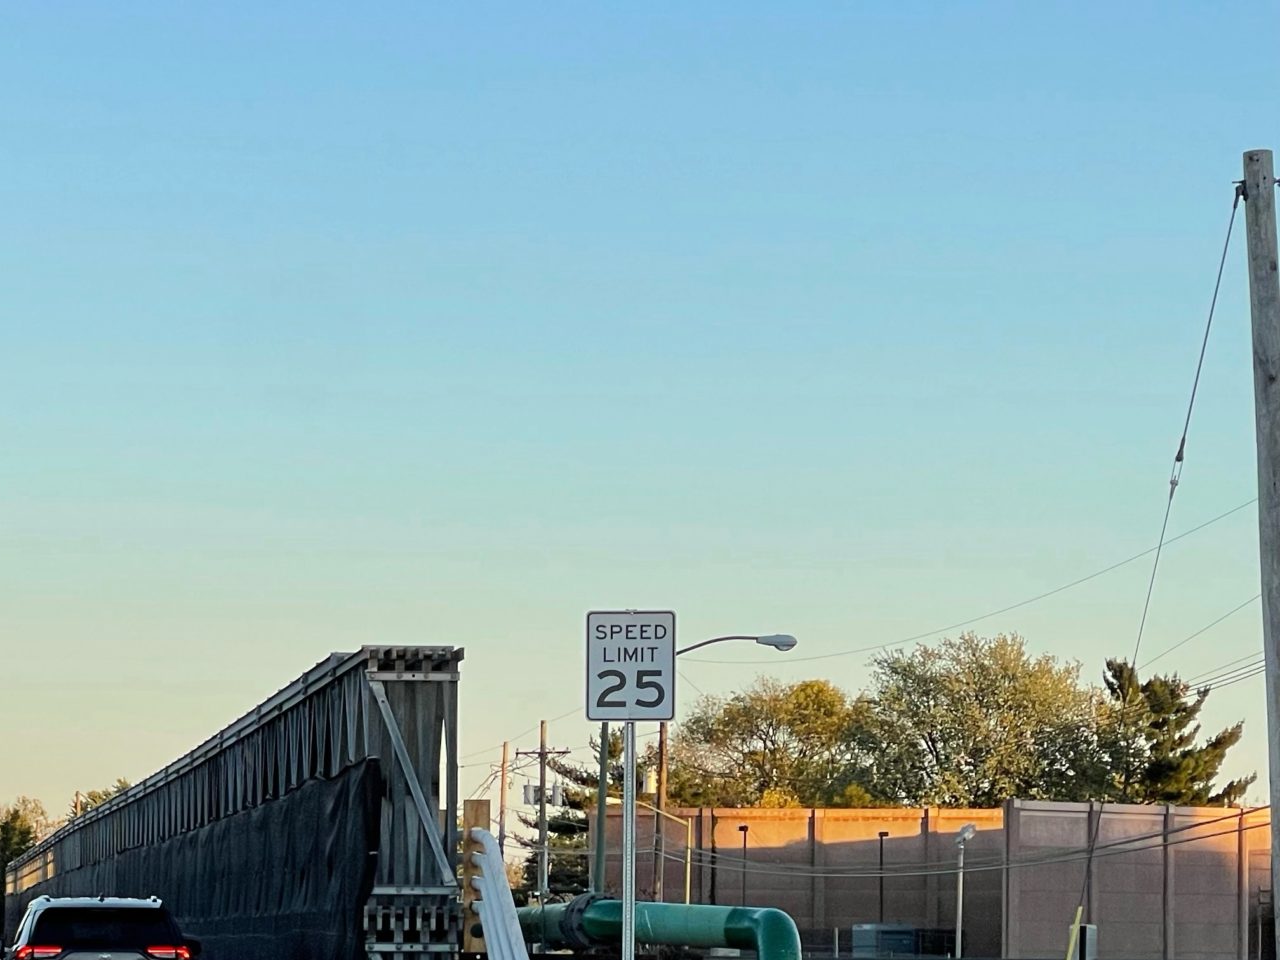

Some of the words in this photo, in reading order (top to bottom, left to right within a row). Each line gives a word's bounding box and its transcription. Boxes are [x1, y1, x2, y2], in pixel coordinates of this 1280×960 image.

[595, 624, 667, 640] SPEED
[603, 646, 659, 662] LIMIT
[596, 669, 665, 708] 25
